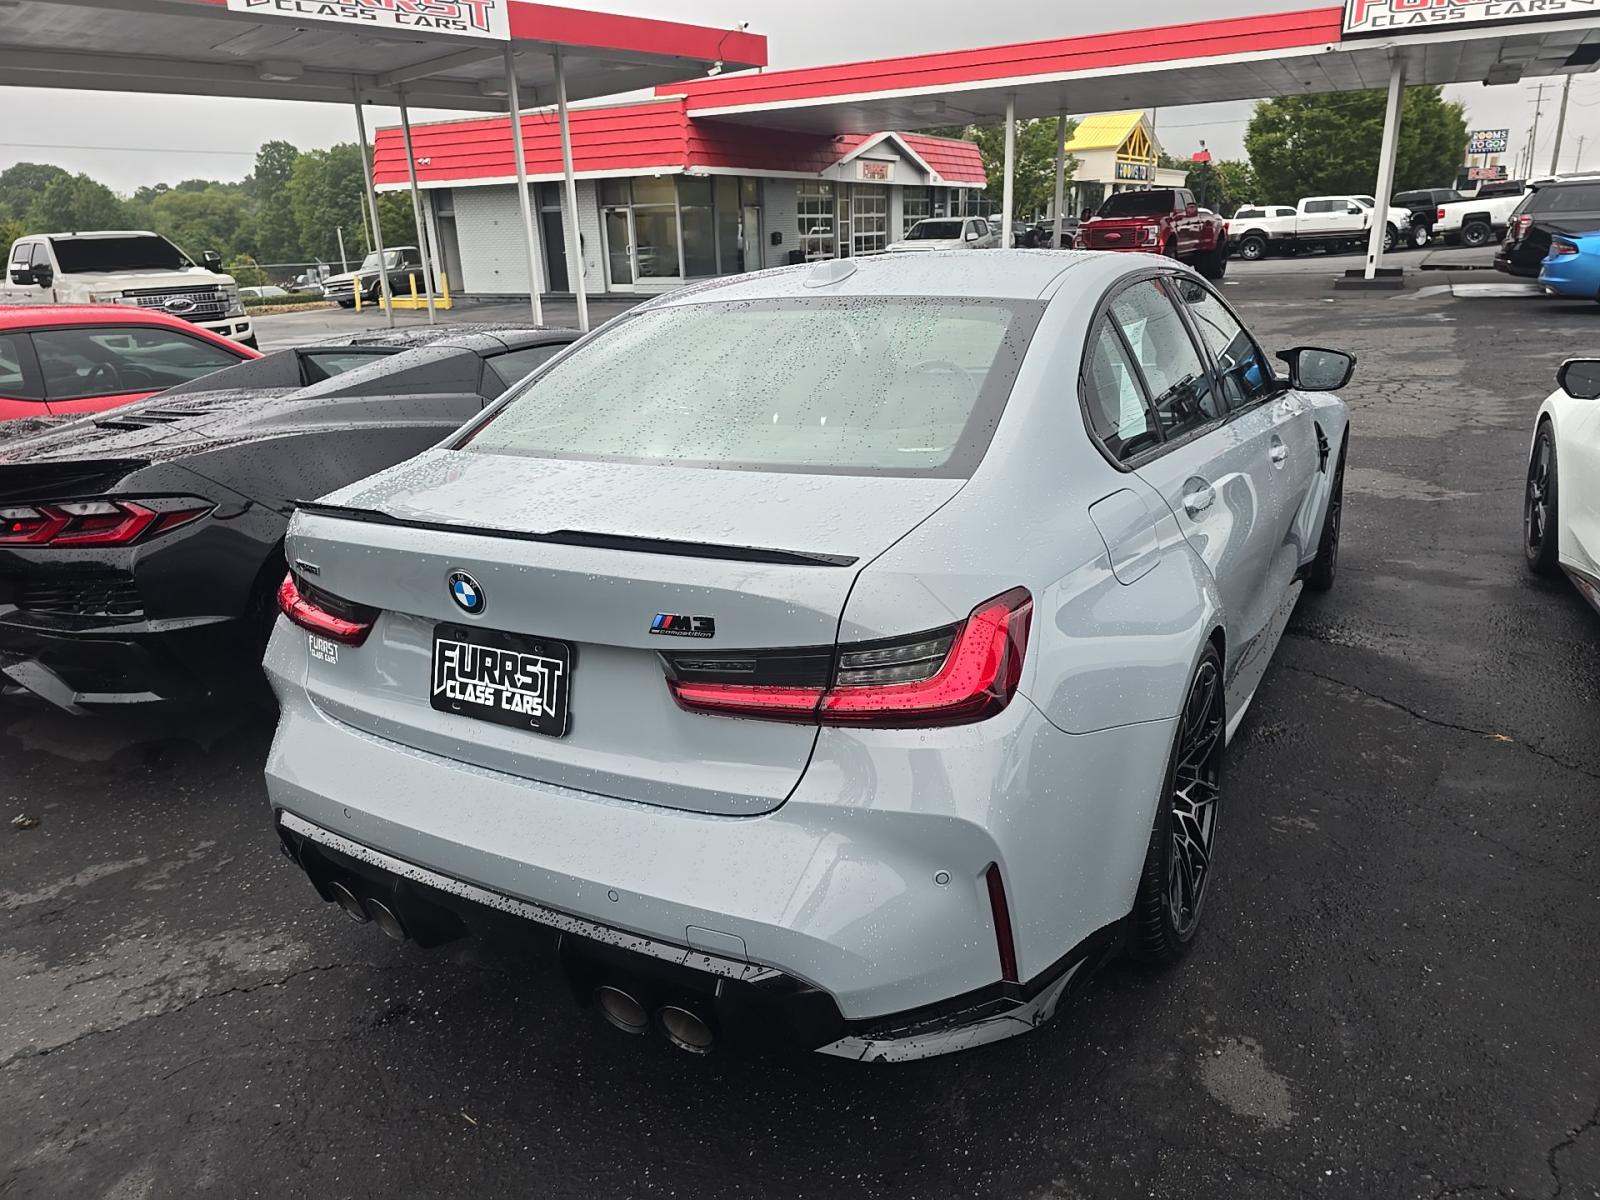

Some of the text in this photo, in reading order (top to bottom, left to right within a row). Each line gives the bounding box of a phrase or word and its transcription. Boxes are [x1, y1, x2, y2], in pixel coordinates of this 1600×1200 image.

[274, 0, 468, 31] CLASS CARS
[1371, 9, 1466, 28] CLASS
[1484, 0, 1566, 17] CARS
[1471, 140, 1500, 149] TO GO
[1473, 131, 1506, 140] ROOMS
[433, 638, 563, 718] FURRST
[445, 679, 543, 717] CLASS CARS
